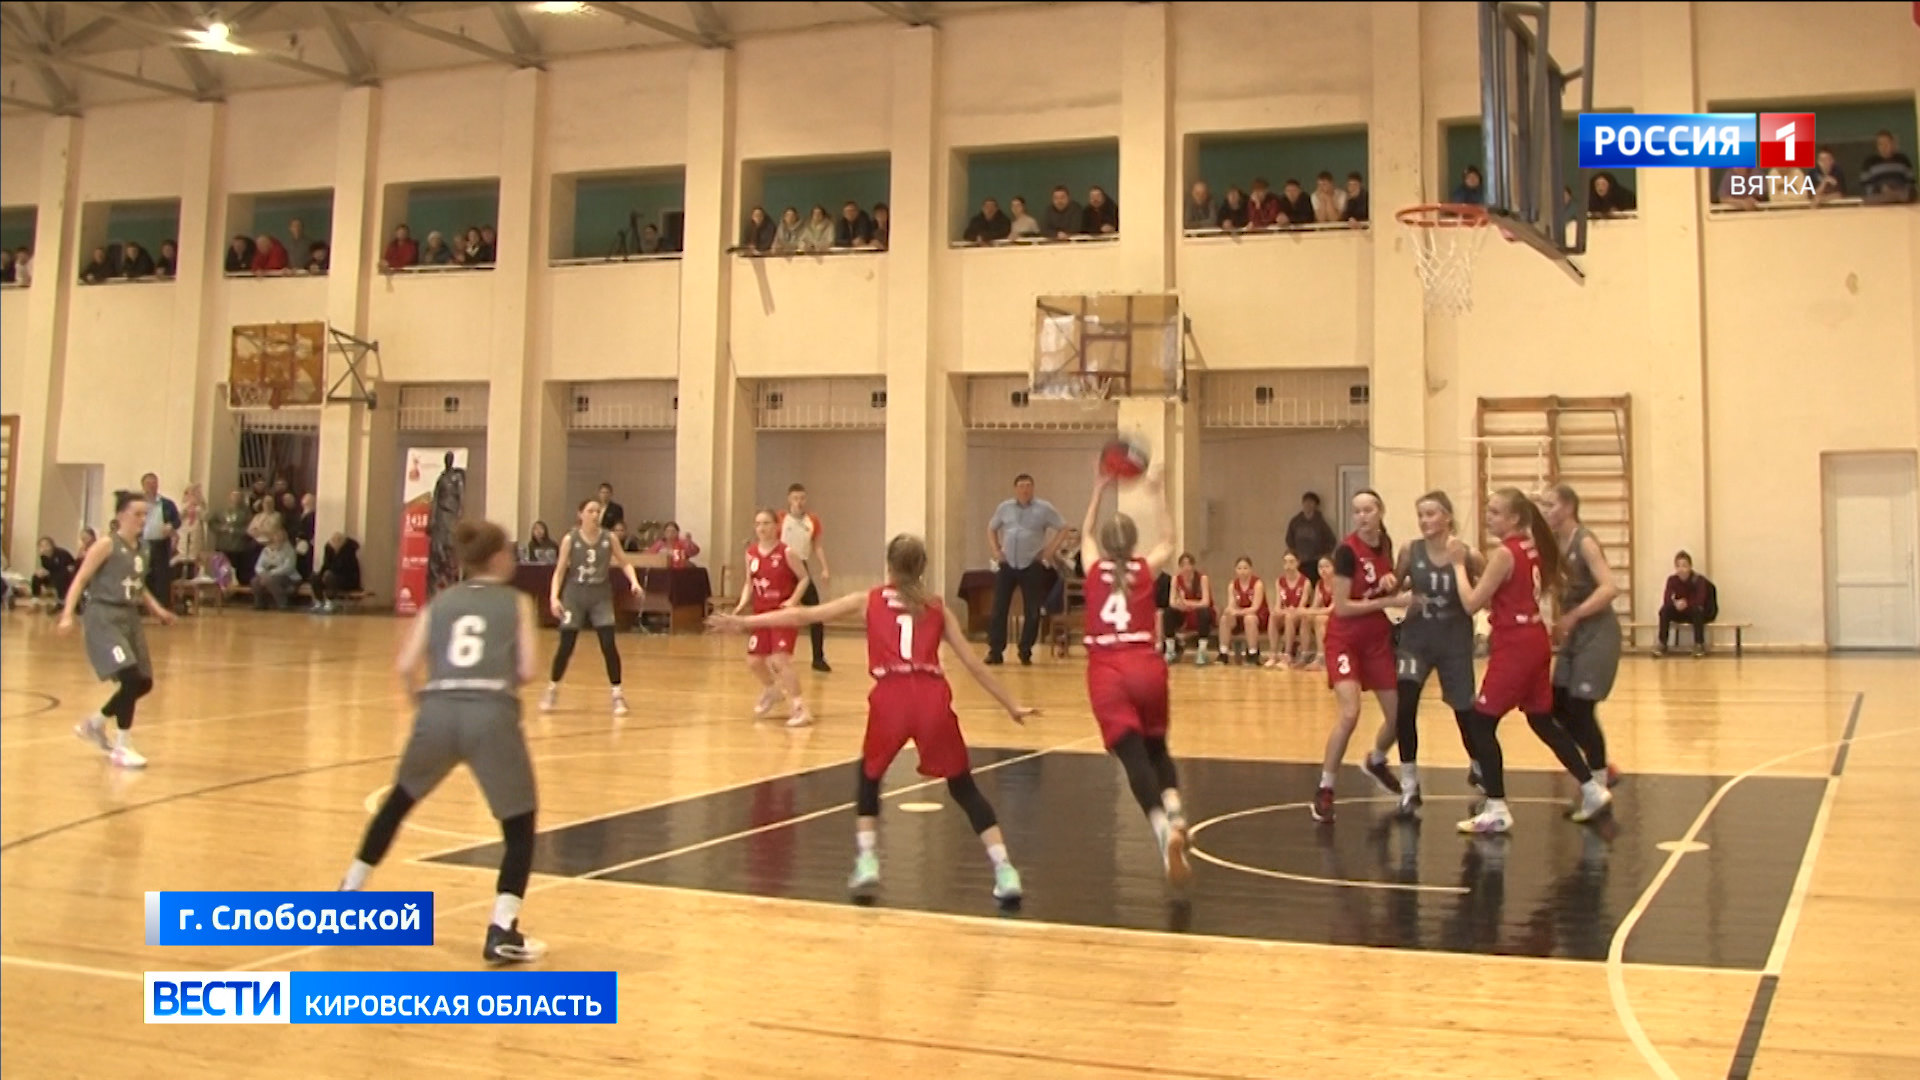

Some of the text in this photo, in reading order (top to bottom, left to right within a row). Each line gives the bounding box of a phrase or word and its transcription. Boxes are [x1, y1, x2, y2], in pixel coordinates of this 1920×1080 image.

[586, 549, 596, 563] 3
[1363, 561, 1377, 584] 3
[1430, 572, 1450, 590] 11
[1100, 589, 1131, 632] 4
[447, 615, 488, 667] 6
[896, 614, 913, 660] 1
[1337, 653, 1351, 675] 3
